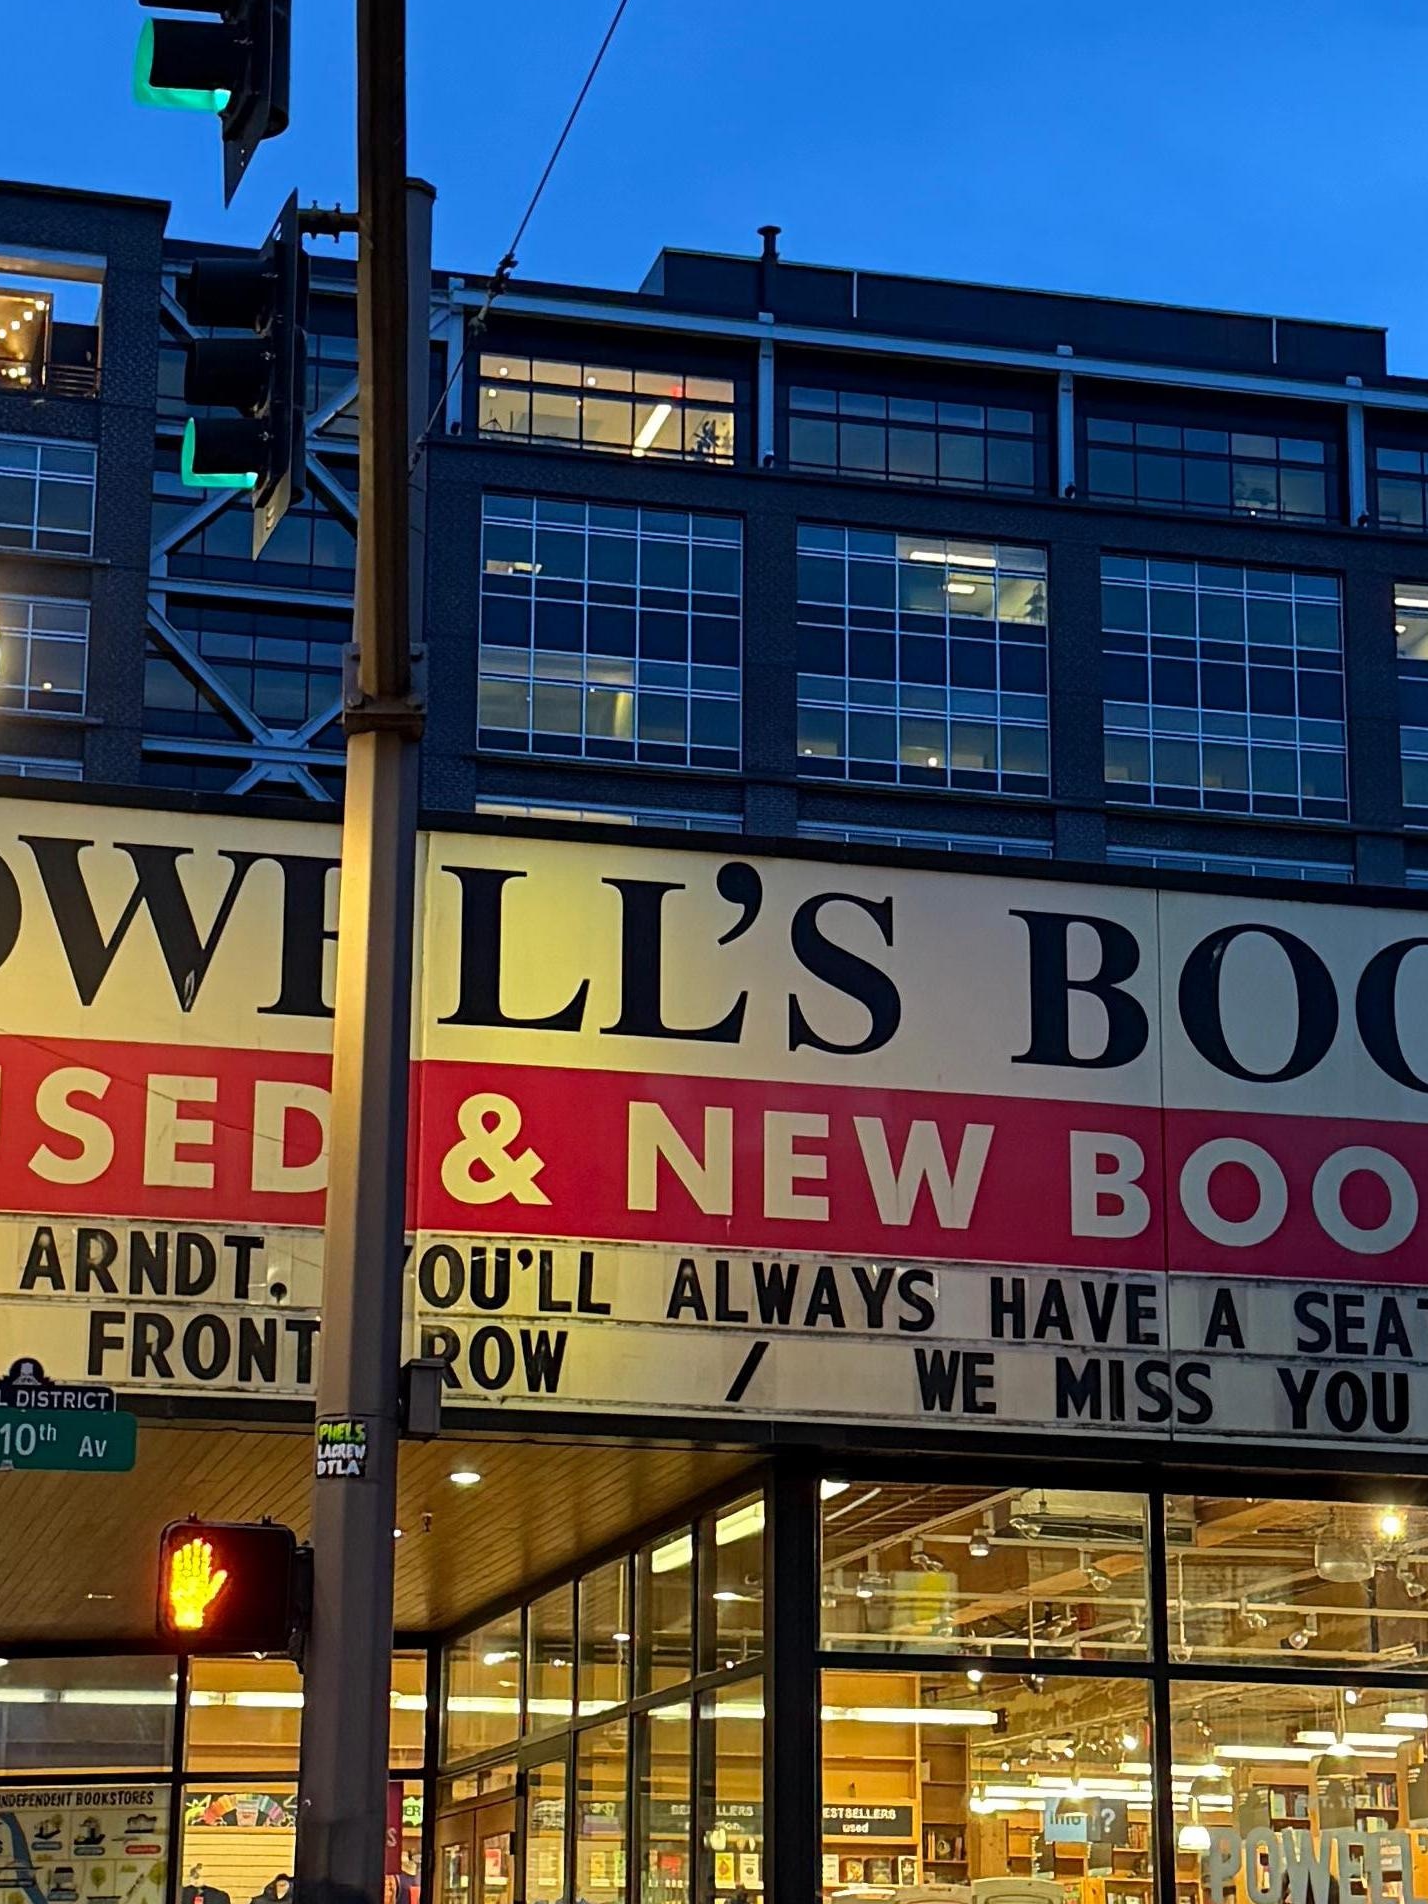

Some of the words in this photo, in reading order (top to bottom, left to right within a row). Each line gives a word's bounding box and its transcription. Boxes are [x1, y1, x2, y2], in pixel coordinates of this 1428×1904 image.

[439, 1091, 552, 1207] &
[627, 1100, 994, 1231] NEW
[20, 1226, 288, 1303] ARNDT.
[404, 1244, 612, 1315] OU'LL
[666, 1258, 936, 1332] ALWAYS
[990, 1277, 1159, 1346] HAVE
[1204, 1287, 1245, 1350] A
[87, 1311, 321, 1383] FRONT
[422, 1323, 568, 1393] ROW
[914, 1348, 997, 1414] WE
[1056, 1356, 1213, 1425] MISS
[1277, 1367, 1410, 1434] YOU
[16, 1390, 109, 1409] DISTRICT
[0, 1422, 57, 1456] 10th
[78, 1436, 107, 1457] Av
[317, 1459, 360, 1475] DTLA
[76, 1791, 154, 1806] BOOKSTORES
[823, 1806, 897, 1820] ESTSELLERS
